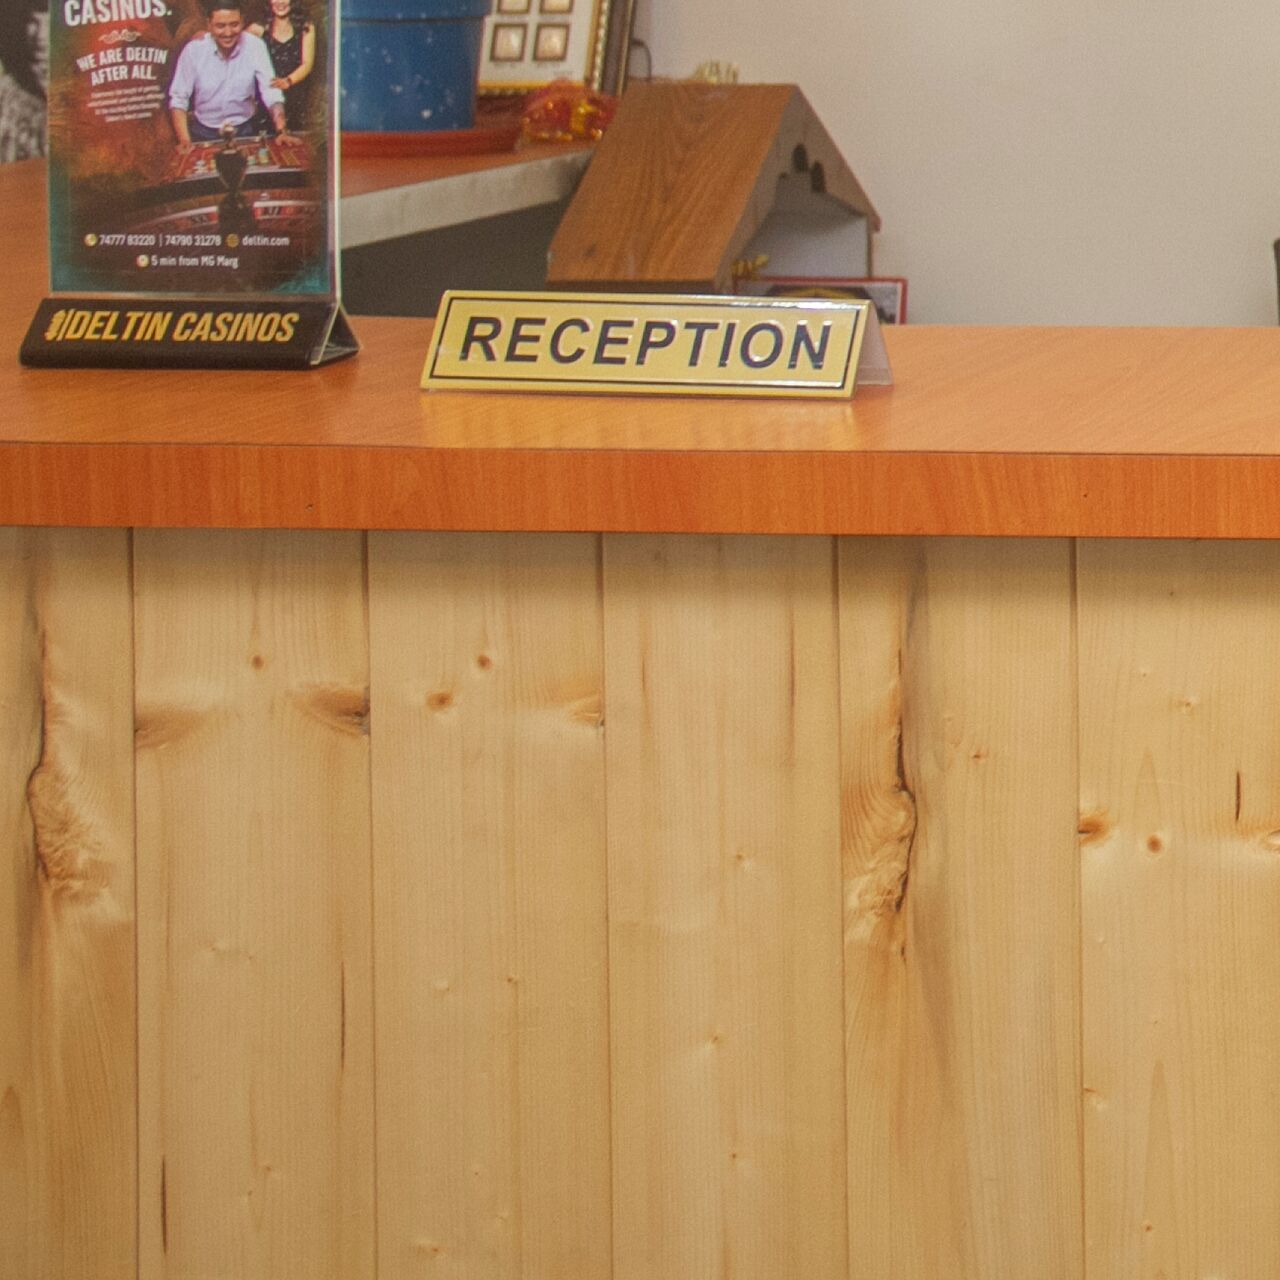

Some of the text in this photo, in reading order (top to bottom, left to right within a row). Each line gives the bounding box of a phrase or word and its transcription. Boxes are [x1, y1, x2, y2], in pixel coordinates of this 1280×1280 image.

[76, 46, 168, 72] WE ARE DELTIN
[91, 64, 129, 87] AFTER
[151, 255, 239, 270] 5 min from MG Marg
[66, 310, 300, 342] DELTIN CASINOS
[459, 316, 834, 371] RECEPTION
